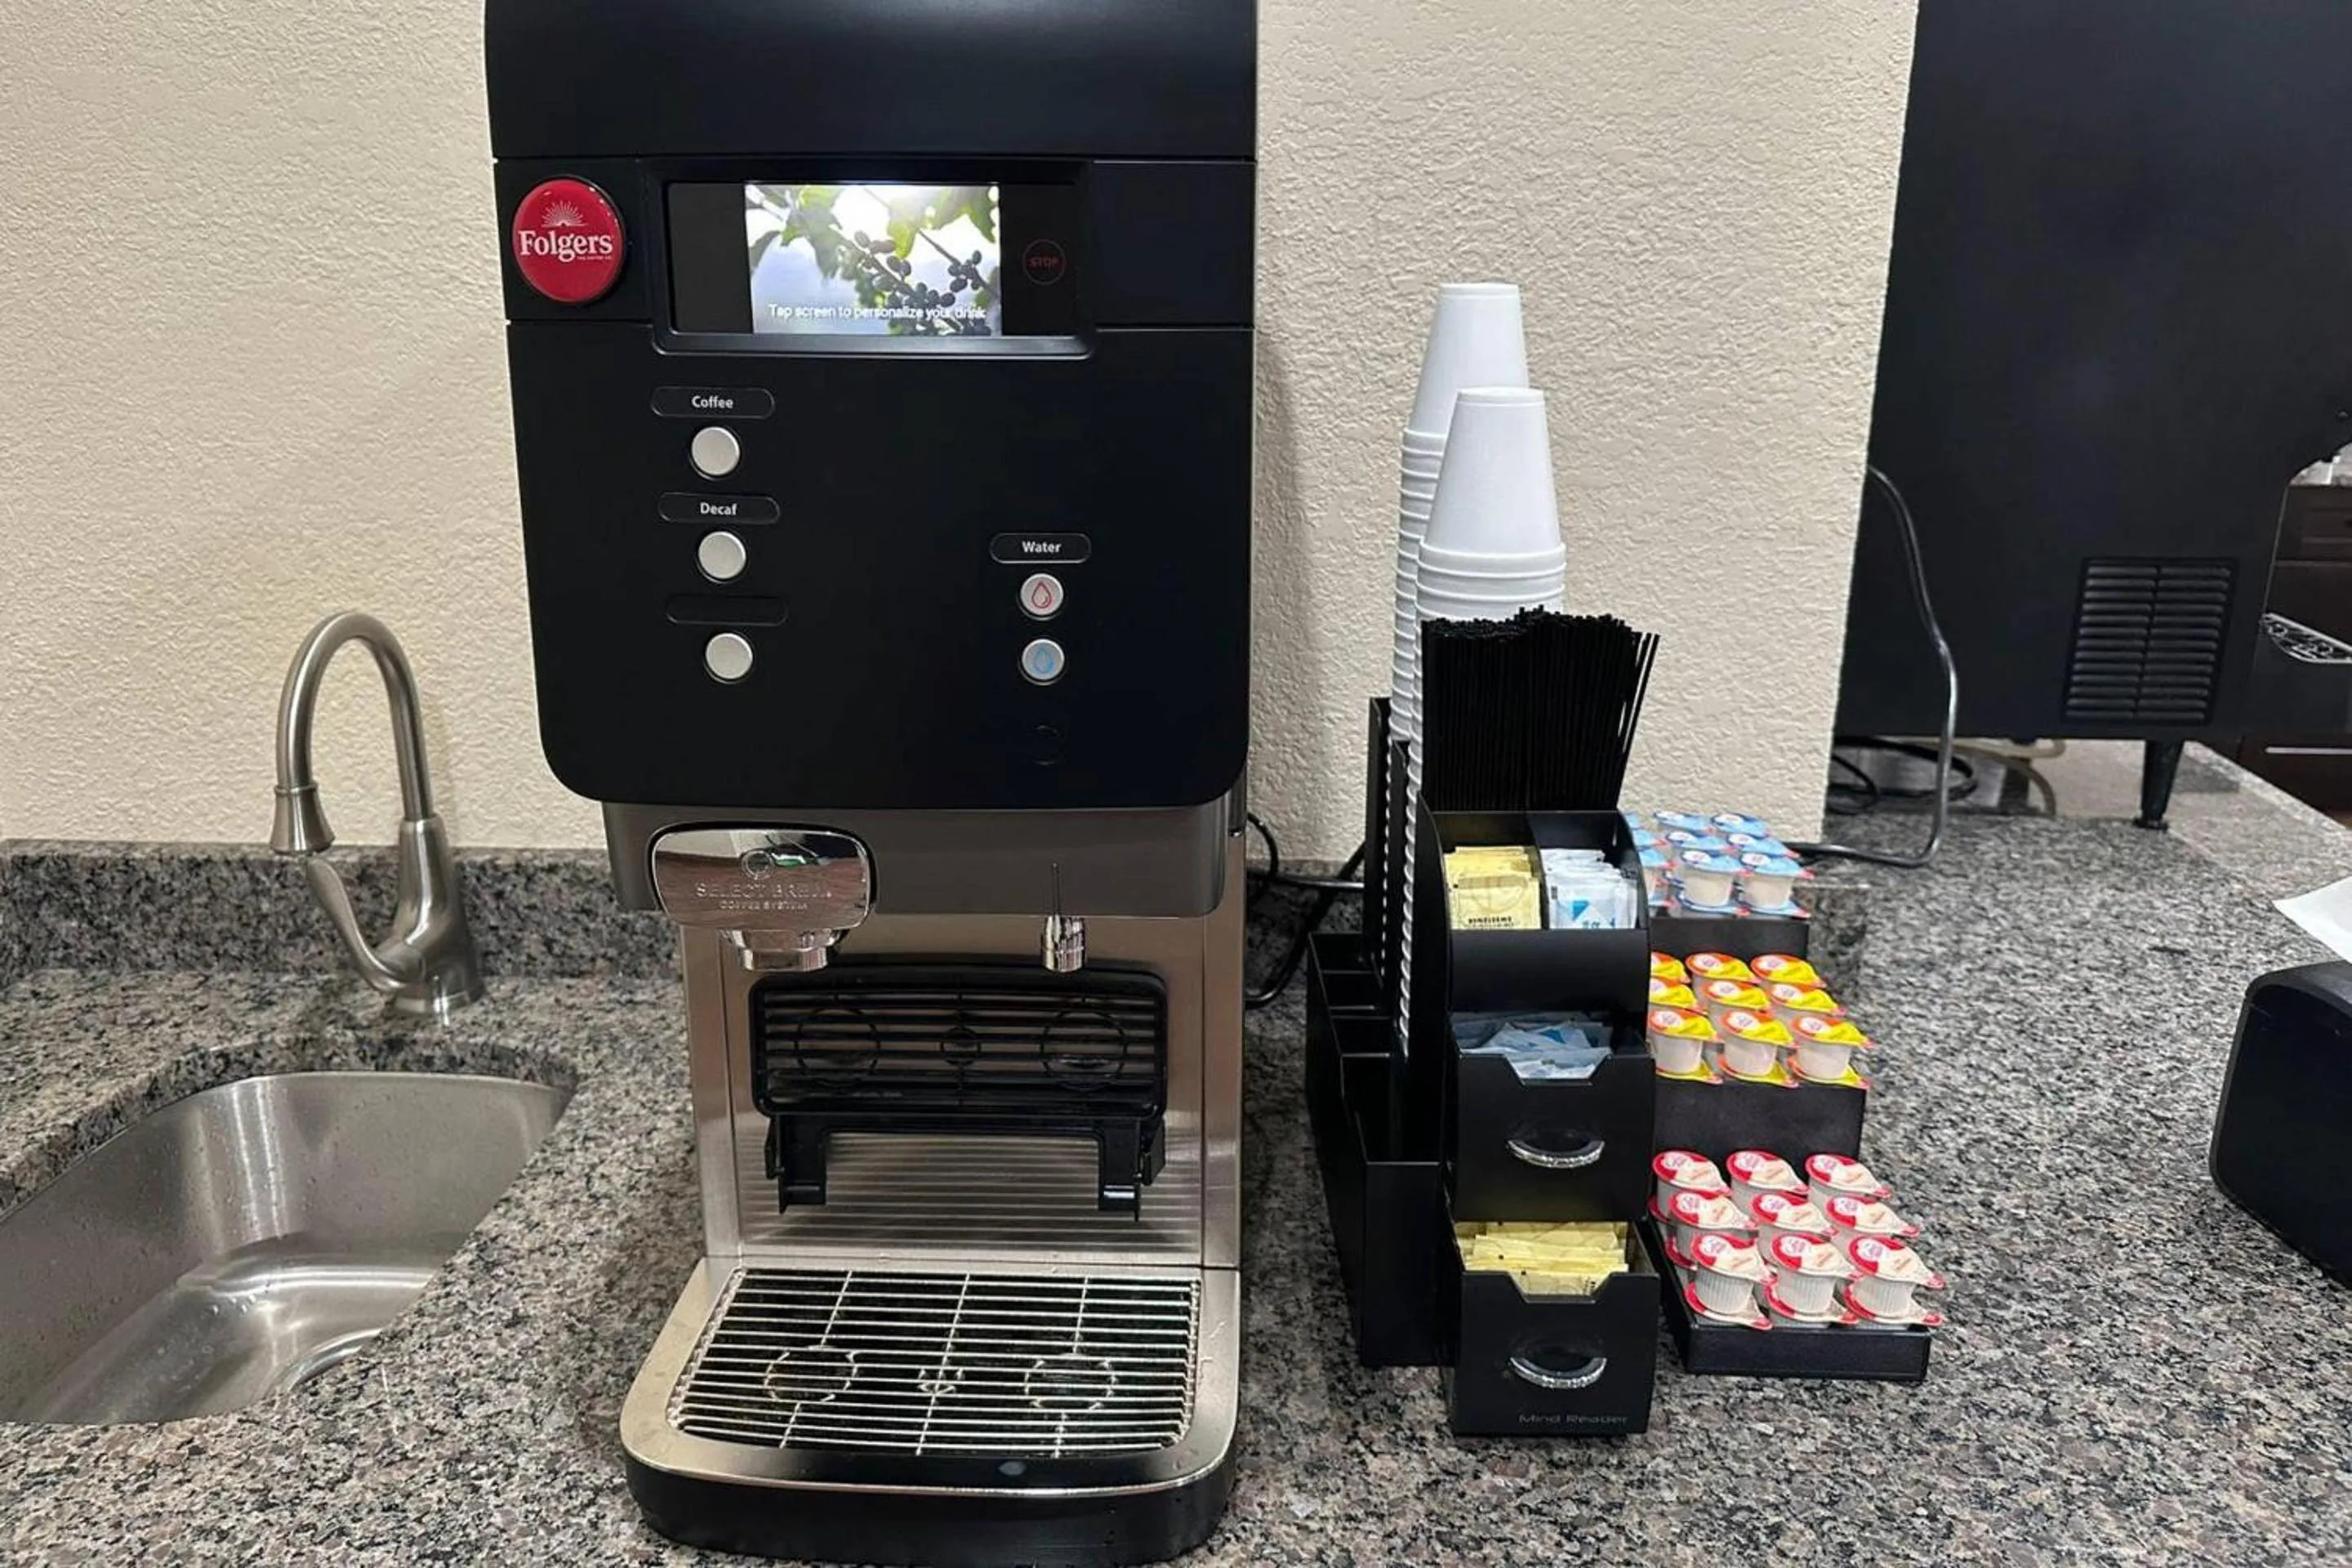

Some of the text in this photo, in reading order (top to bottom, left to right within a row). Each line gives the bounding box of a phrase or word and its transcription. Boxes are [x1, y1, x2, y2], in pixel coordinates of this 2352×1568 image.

[519, 229, 613, 262] Folgers
[768, 303, 986, 322] Tap screen to personalize your drink
[691, 395, 734, 408] Coffee
[699, 502, 737, 515] Decaf
[1022, 541, 1062, 553] Water
[1518, 1414, 1628, 1424] Mind Reader
